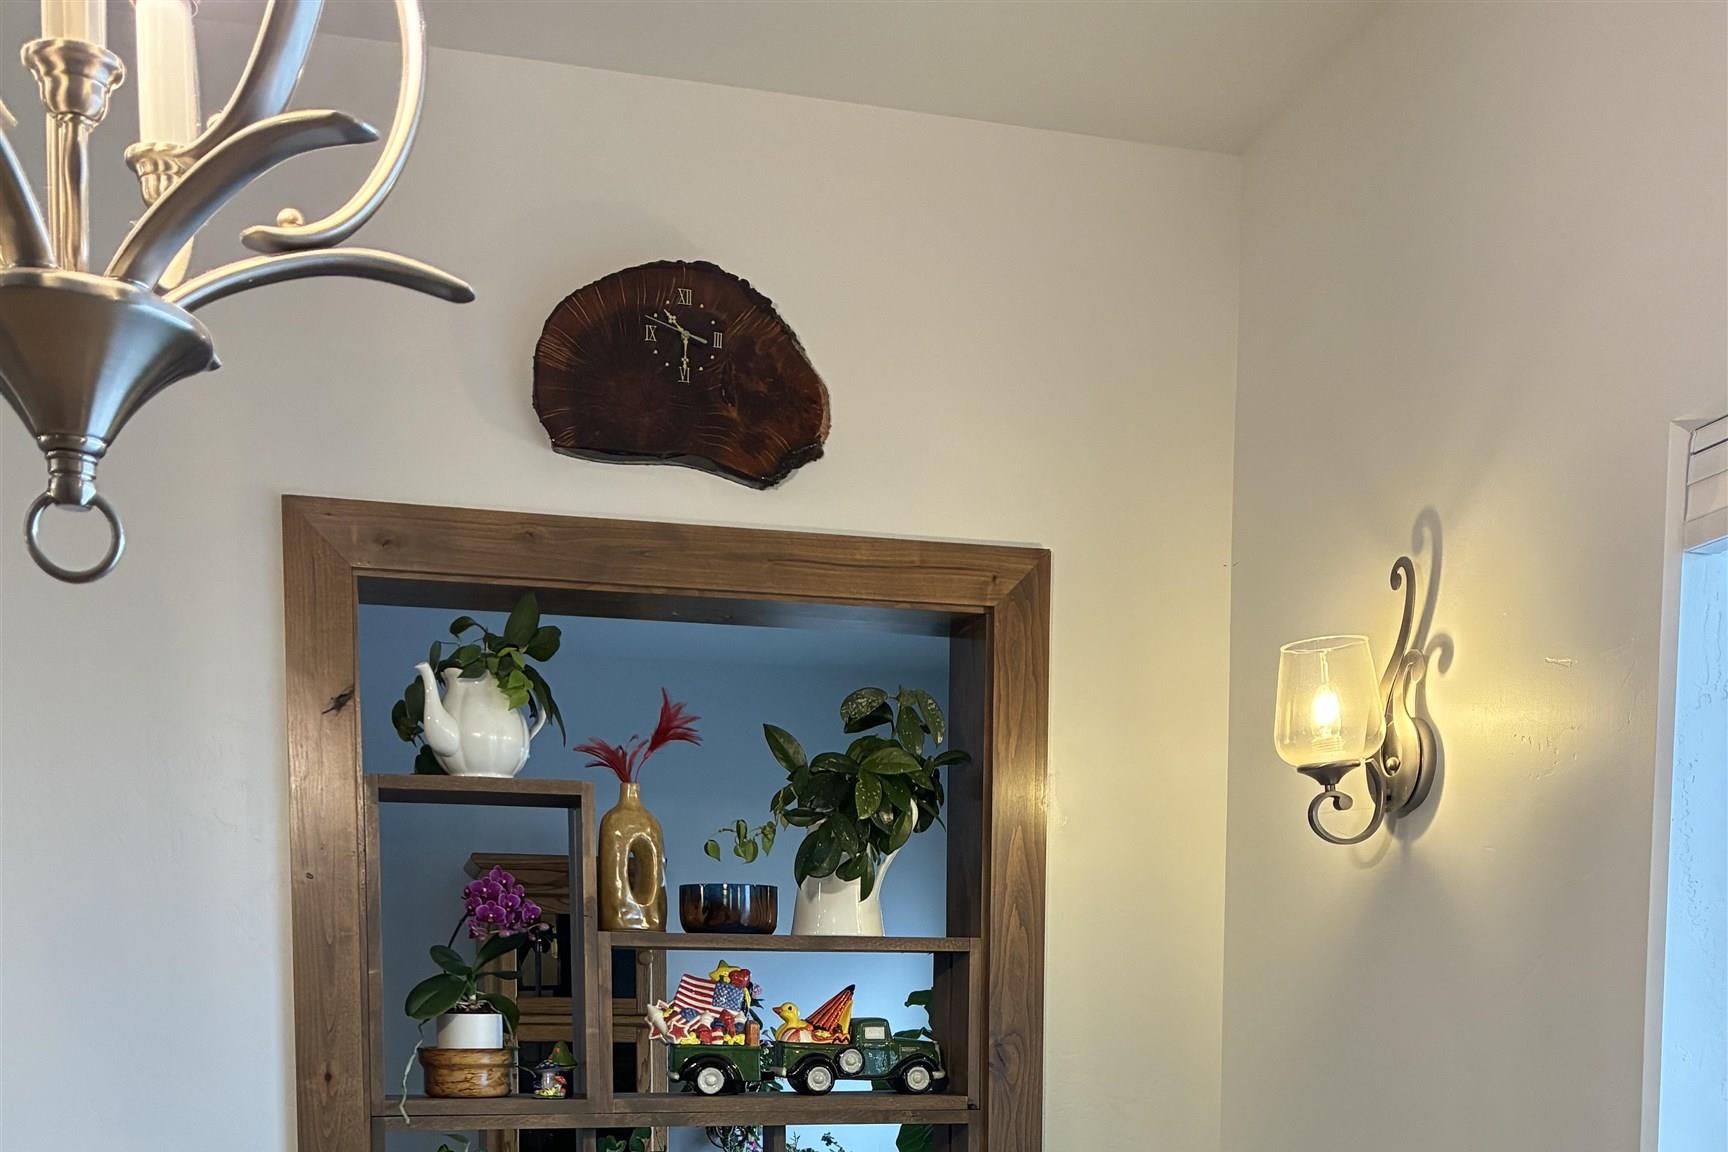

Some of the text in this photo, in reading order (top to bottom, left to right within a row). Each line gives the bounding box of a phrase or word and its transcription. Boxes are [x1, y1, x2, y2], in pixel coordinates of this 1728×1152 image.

[678, 288, 692, 306] XII
[645, 325, 657, 341] IX
[713, 331, 723, 349] III
